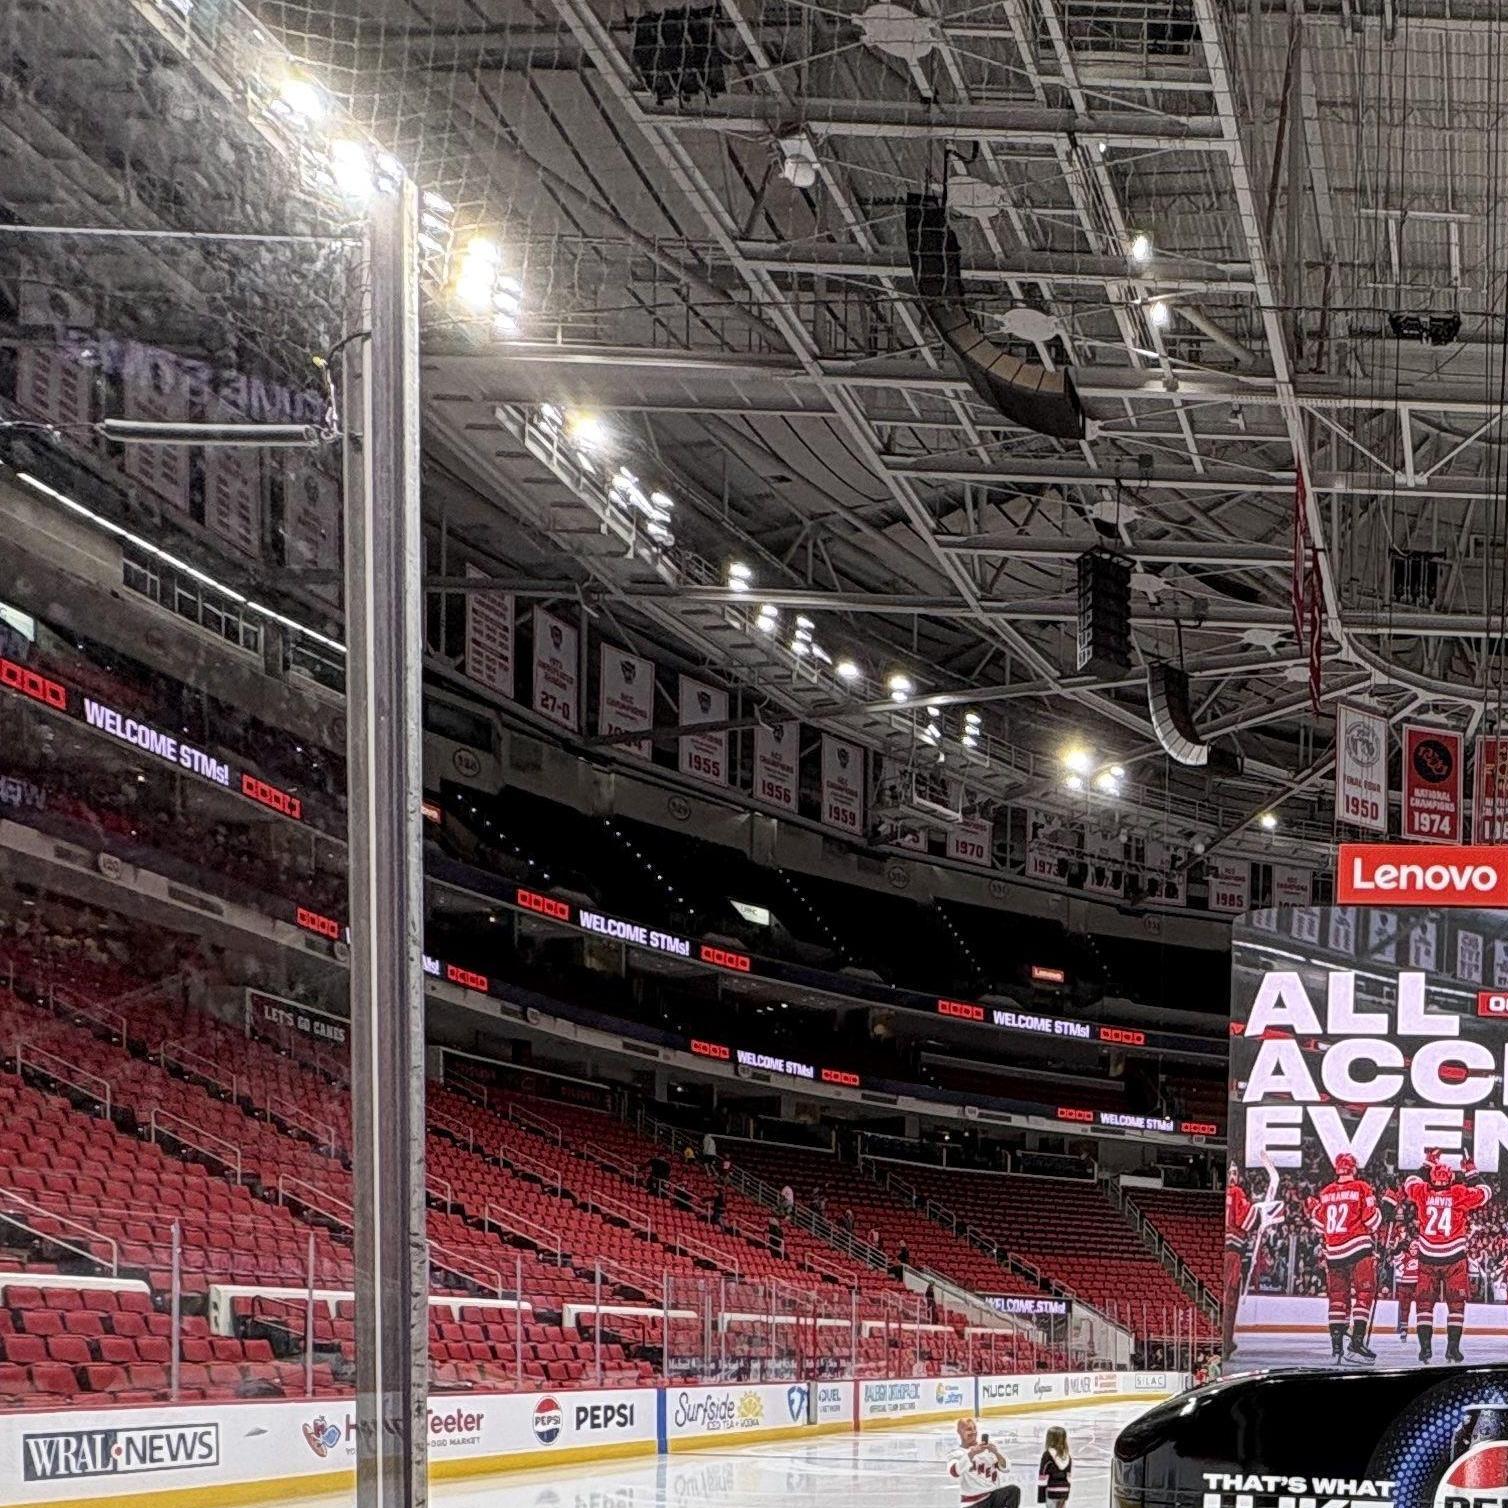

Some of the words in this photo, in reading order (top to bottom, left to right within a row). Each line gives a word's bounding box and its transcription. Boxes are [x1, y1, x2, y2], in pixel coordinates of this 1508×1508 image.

[84, 696, 179, 763] WELCOME
[178, 747, 230, 787] STMs!
[688, 752, 721, 777] 1955
[762, 778, 792, 804] 1956
[828, 804, 856, 826] 1959
[1344, 794, 1380, 822] 1950
[1413, 811, 1452, 835] 1974
[955, 839, 984, 859] 1970
[1352, 857, 1498, 892] Lenovo
[1216, 892, 1244, 908] 1985
[579, 909, 648, 947] WELCOME
[649, 930, 691, 957] STMs!
[1244, 971, 1460, 1037] ALL
[992, 1009, 1053, 1034] WELCOME
[1054, 1020, 1091, 1040] STMs!
[736, 1048, 783, 1074] WELCOME
[784, 1059, 815, 1080] STMs!
[1101, 1112, 1146, 1130] WELCOME
[1326, 1203, 1349, 1235] 82
[1424, 1206, 1452, 1237] 24
[534, 1415, 561, 1427] PEPSI
[575, 1402, 635, 1431] PEPSI
[674, 1391, 736, 1428] Surfside
[26, 1432, 114, 1478] WRAL
[124, 1430, 214, 1466] NEWS
[1203, 1473, 1307, 1493] THAT'S
[1311, 1477, 1396, 1497] WHAT
